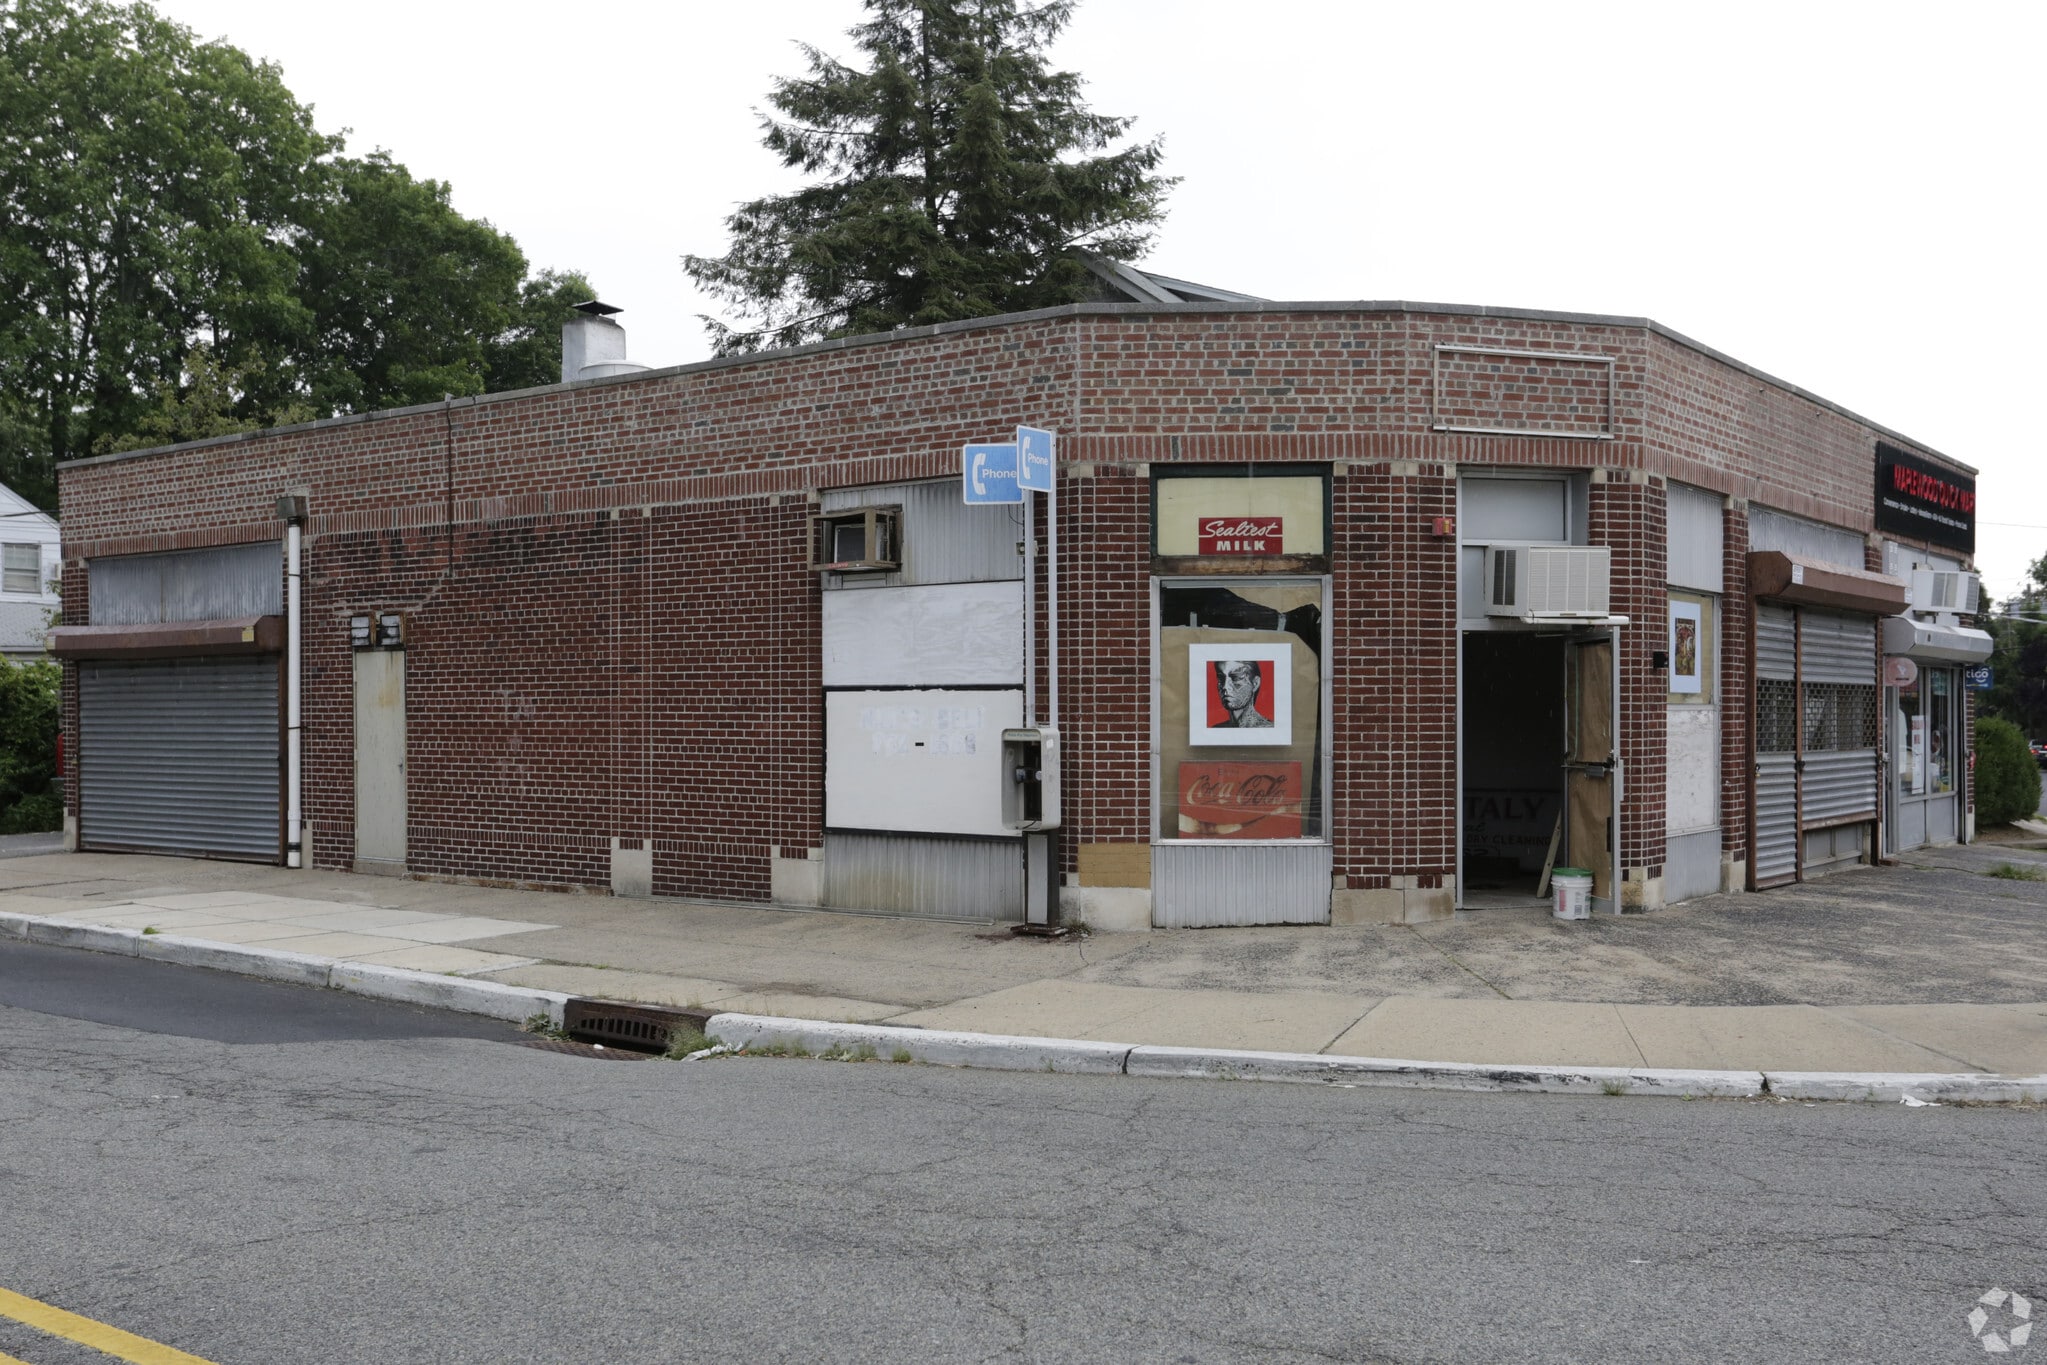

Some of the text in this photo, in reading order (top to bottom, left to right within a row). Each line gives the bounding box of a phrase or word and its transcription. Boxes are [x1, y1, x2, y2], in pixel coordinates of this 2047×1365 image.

[1028, 452, 1049, 466] Phone
[982, 468, 1017, 479] Phone
[1201, 520, 1282, 538] Sealtest
[1216, 540, 1265, 551] MILK
